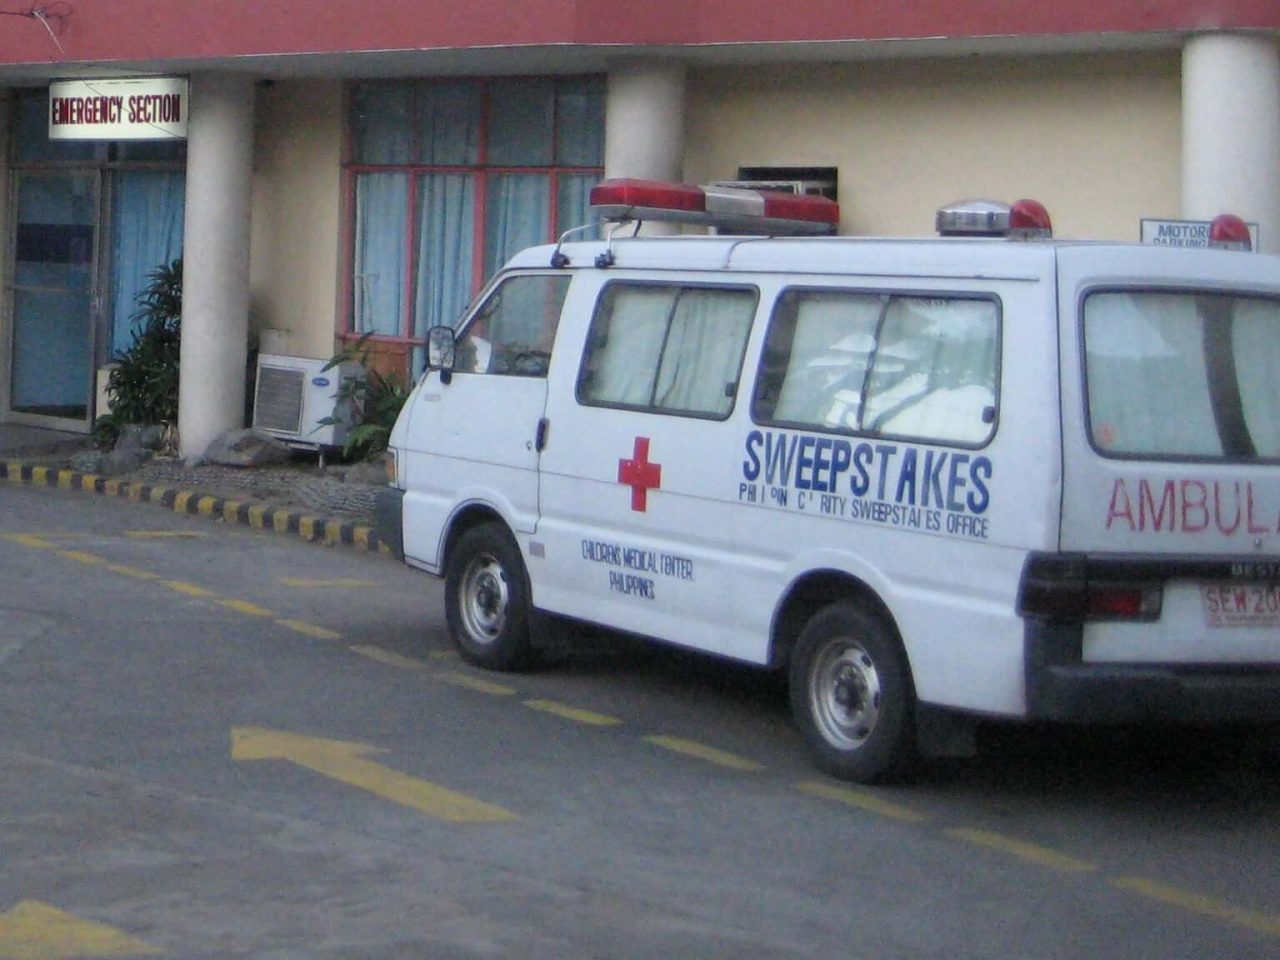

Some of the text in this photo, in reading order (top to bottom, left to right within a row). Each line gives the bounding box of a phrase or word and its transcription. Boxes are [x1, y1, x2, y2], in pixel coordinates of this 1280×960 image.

[52, 94, 180, 125] EMERGENCY SECTION
[1158, 224, 1209, 238] MOTOR
[743, 430, 992, 515] SWEEPSTAKES
[1106, 478, 1280, 537] AMBUL
[946, 513, 990, 539] OFFICE
[622, 547, 658, 573] MEDICAL
[609, 570, 656, 600] PHILIPPINES
